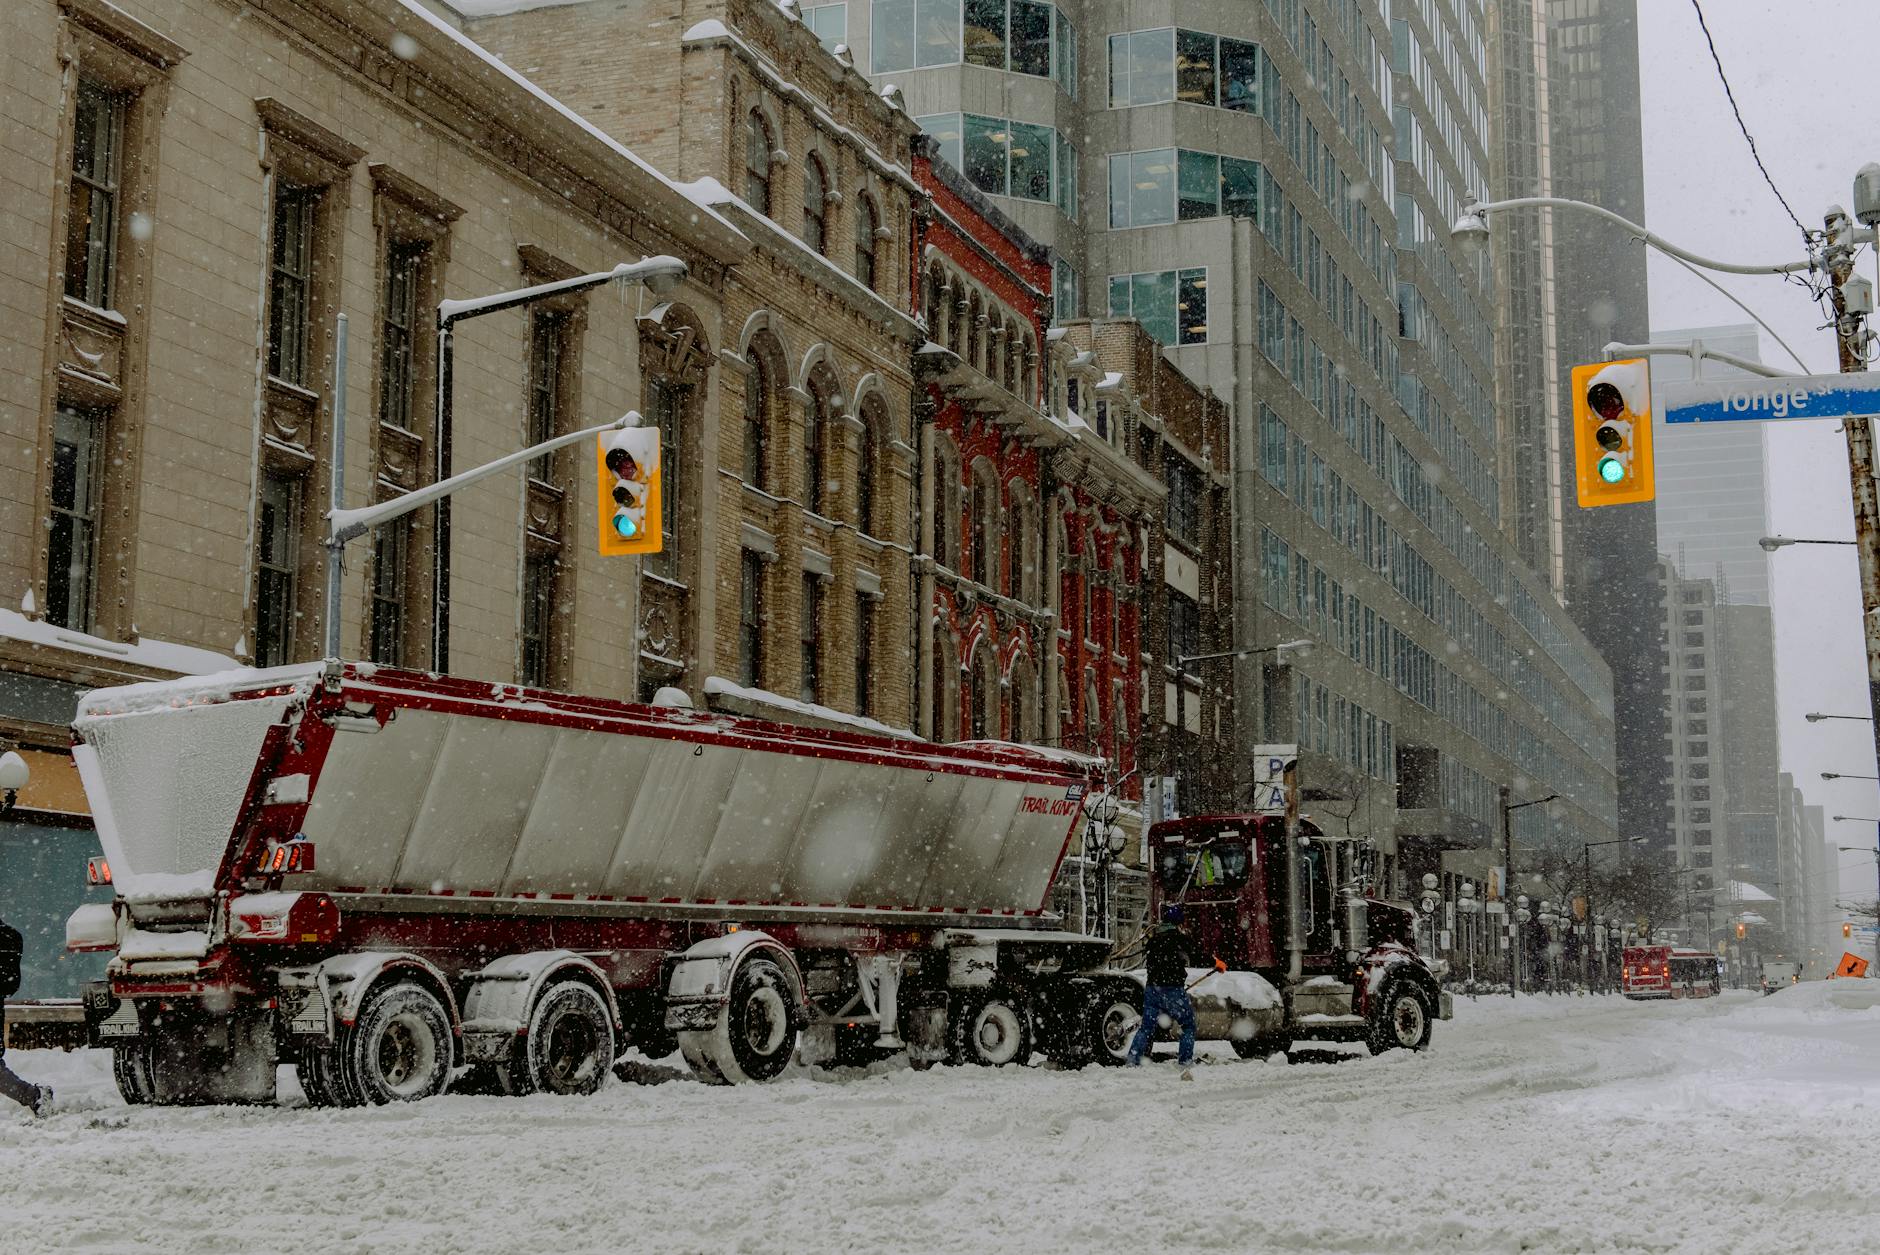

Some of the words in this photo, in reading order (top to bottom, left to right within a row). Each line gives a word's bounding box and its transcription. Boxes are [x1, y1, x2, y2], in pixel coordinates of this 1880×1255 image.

[1718, 385, 1808, 417] Yonge
[1022, 796, 1048, 815] TRAIL
[1049, 799, 1077, 817] KING
